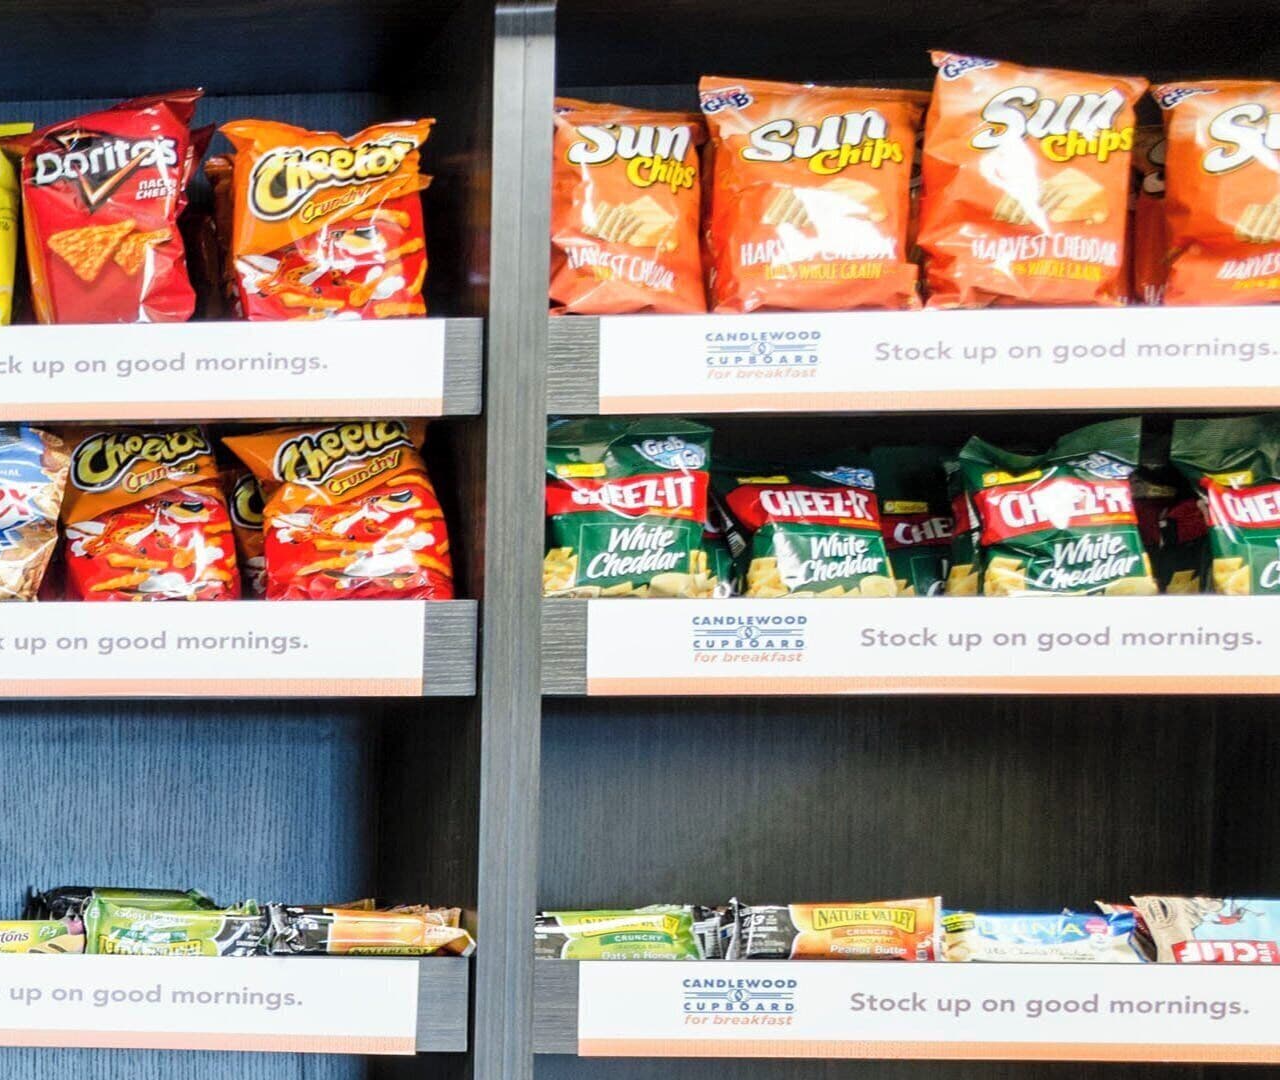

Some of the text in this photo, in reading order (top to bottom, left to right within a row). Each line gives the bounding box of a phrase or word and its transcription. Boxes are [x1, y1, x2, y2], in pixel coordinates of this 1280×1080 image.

[741, 109, 888, 163] Sun
[34, 136, 178, 185] Doritos
[808, 138, 904, 176] Chips
[252, 138, 418, 220] Cheetos
[32, 360, 65, 379] up
[74, 359, 107, 373] on
[116, 351, 186, 378] good
[195, 351, 328, 376] mornings.
[875, 337, 1278, 365] Stock up on good mornings.
[759, 488, 873, 520] CHEEZ-IT
[608, 525, 675, 553] White
[586, 550, 686, 579] Cheddar
[14, 636, 47, 656] up
[55, 636, 89, 651] on
[97, 630, 167, 656] good
[176, 630, 309, 655] mornings.
[860, 625, 1263, 653] Stock up on good mornings.
[816, 908, 916, 929] NATURE VALLEY
[9, 987, 43, 1007] up
[51, 988, 84, 1002] on
[92, 983, 162, 1008] good
[171, 986, 303, 1011] mornings.
[681, 978, 798, 989] CANDLEWOOD
[682, 1000, 796, 1012] CUPBOARD
[682, 1013, 794, 1026] for breakfast
[849, 991, 1250, 1021] Stock up on good mornings.
